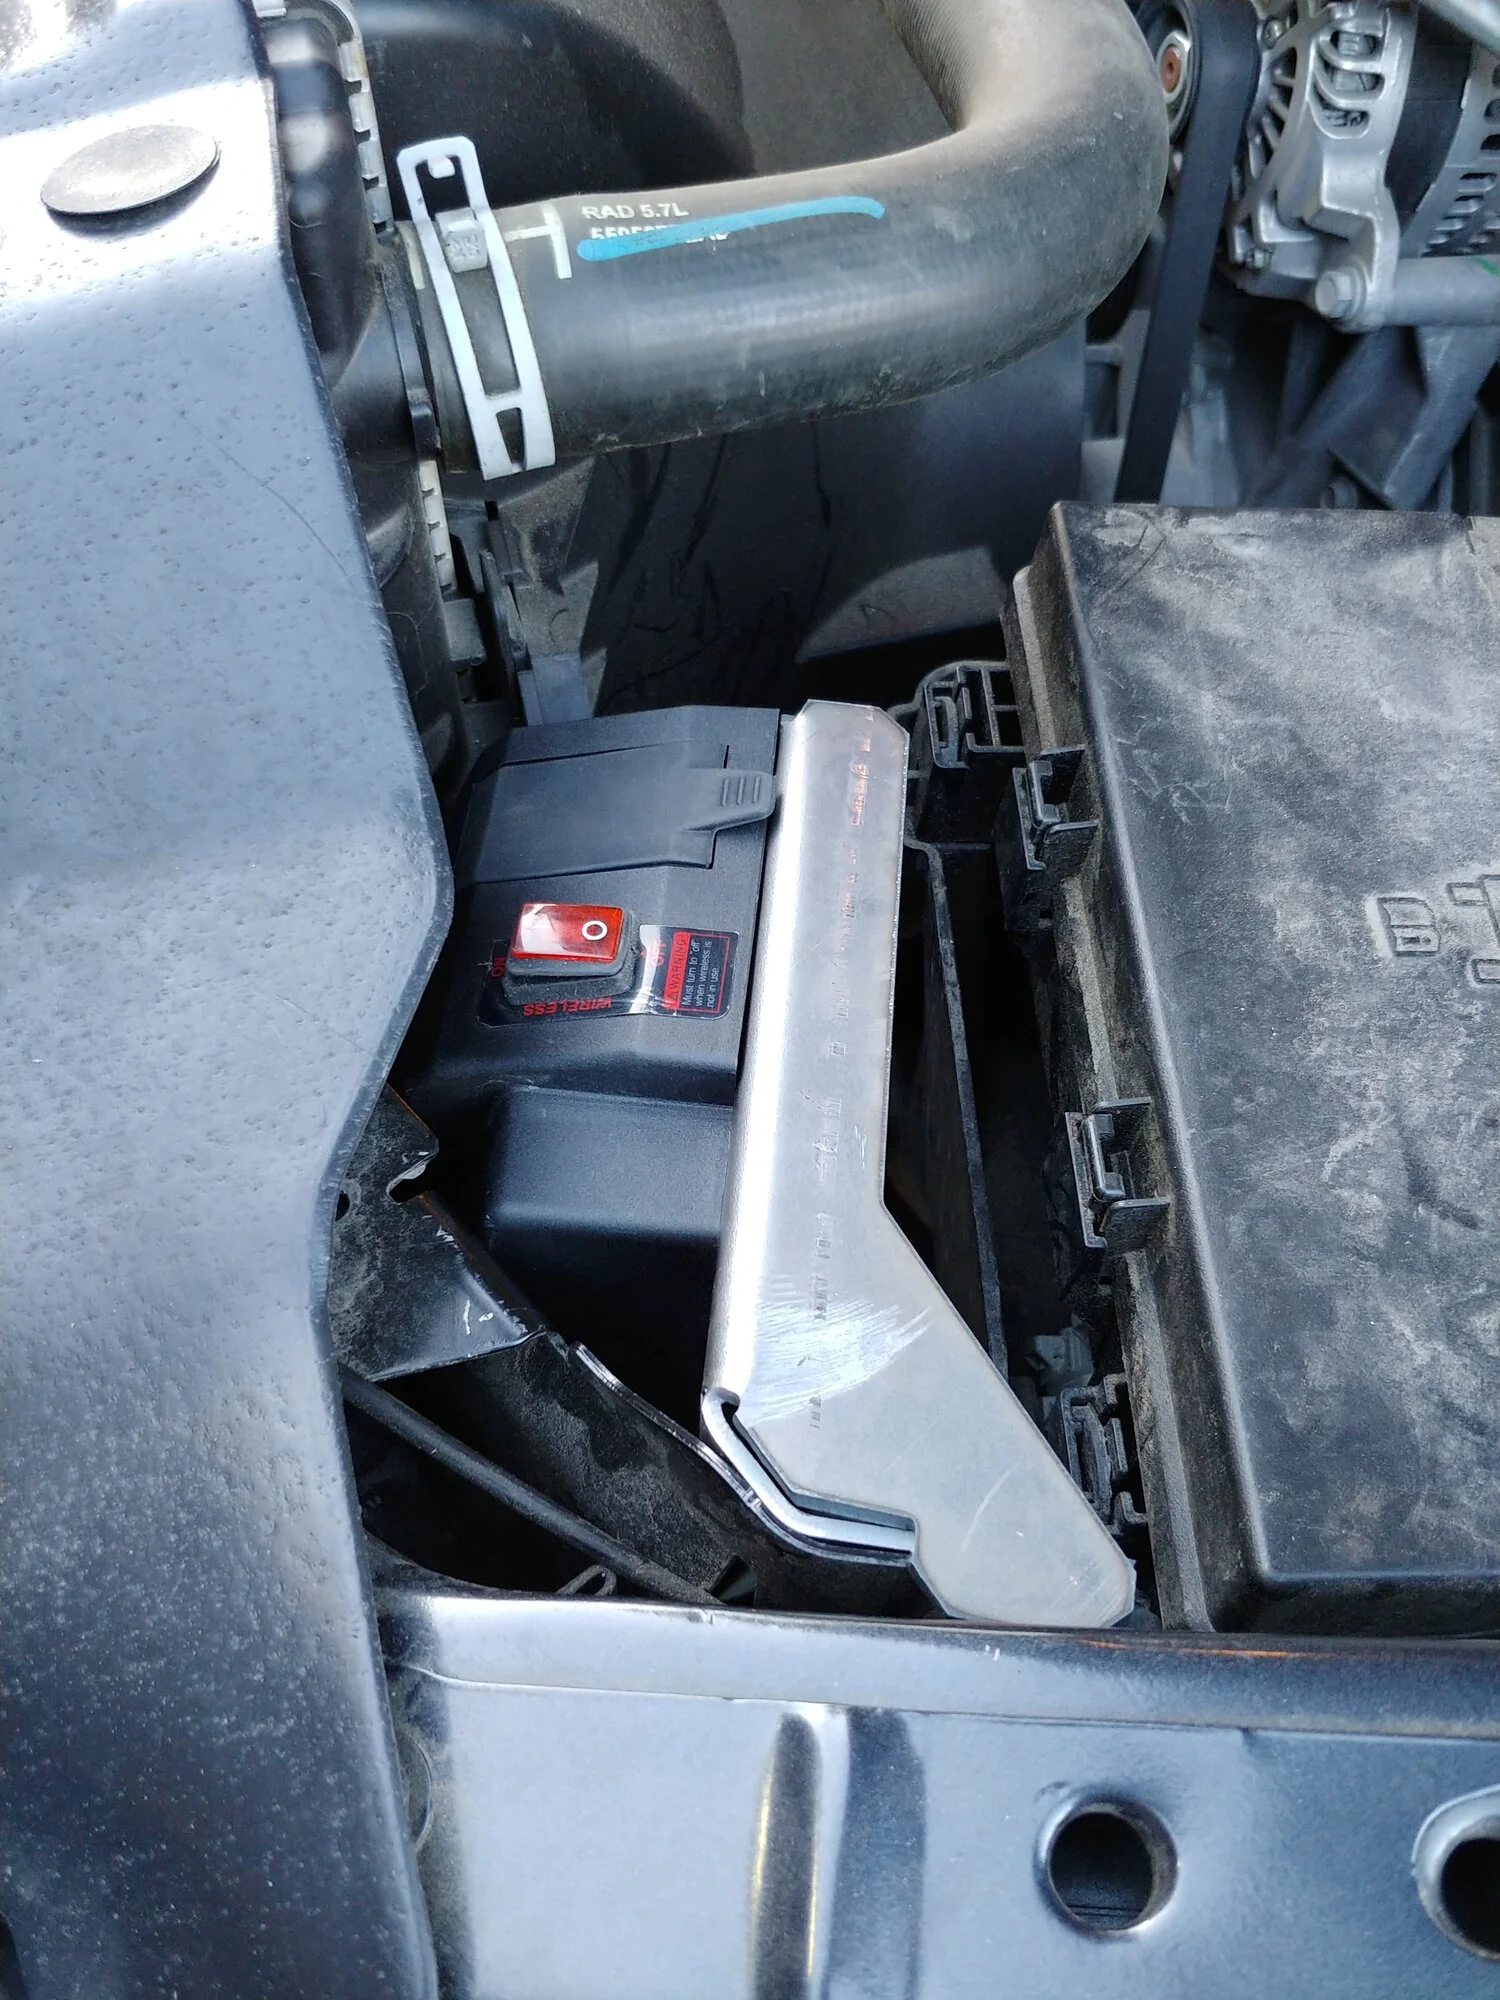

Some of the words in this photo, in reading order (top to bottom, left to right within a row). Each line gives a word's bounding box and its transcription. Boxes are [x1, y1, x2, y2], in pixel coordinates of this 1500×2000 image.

[582, 205, 635, 219] RAD
[640, 203, 689, 218] 5.7L
[671, 939, 686, 988] WARNING
[689, 957, 698, 965] to
[688, 967, 697, 983] turn
[694, 984, 705, 1007] when
[700, 950, 711, 981] wireless
[681, 985, 694, 1006] Must
[710, 984, 716, 992] in
[522, 996, 612, 1017] WIRELESS
[707, 994, 715, 1008] not
